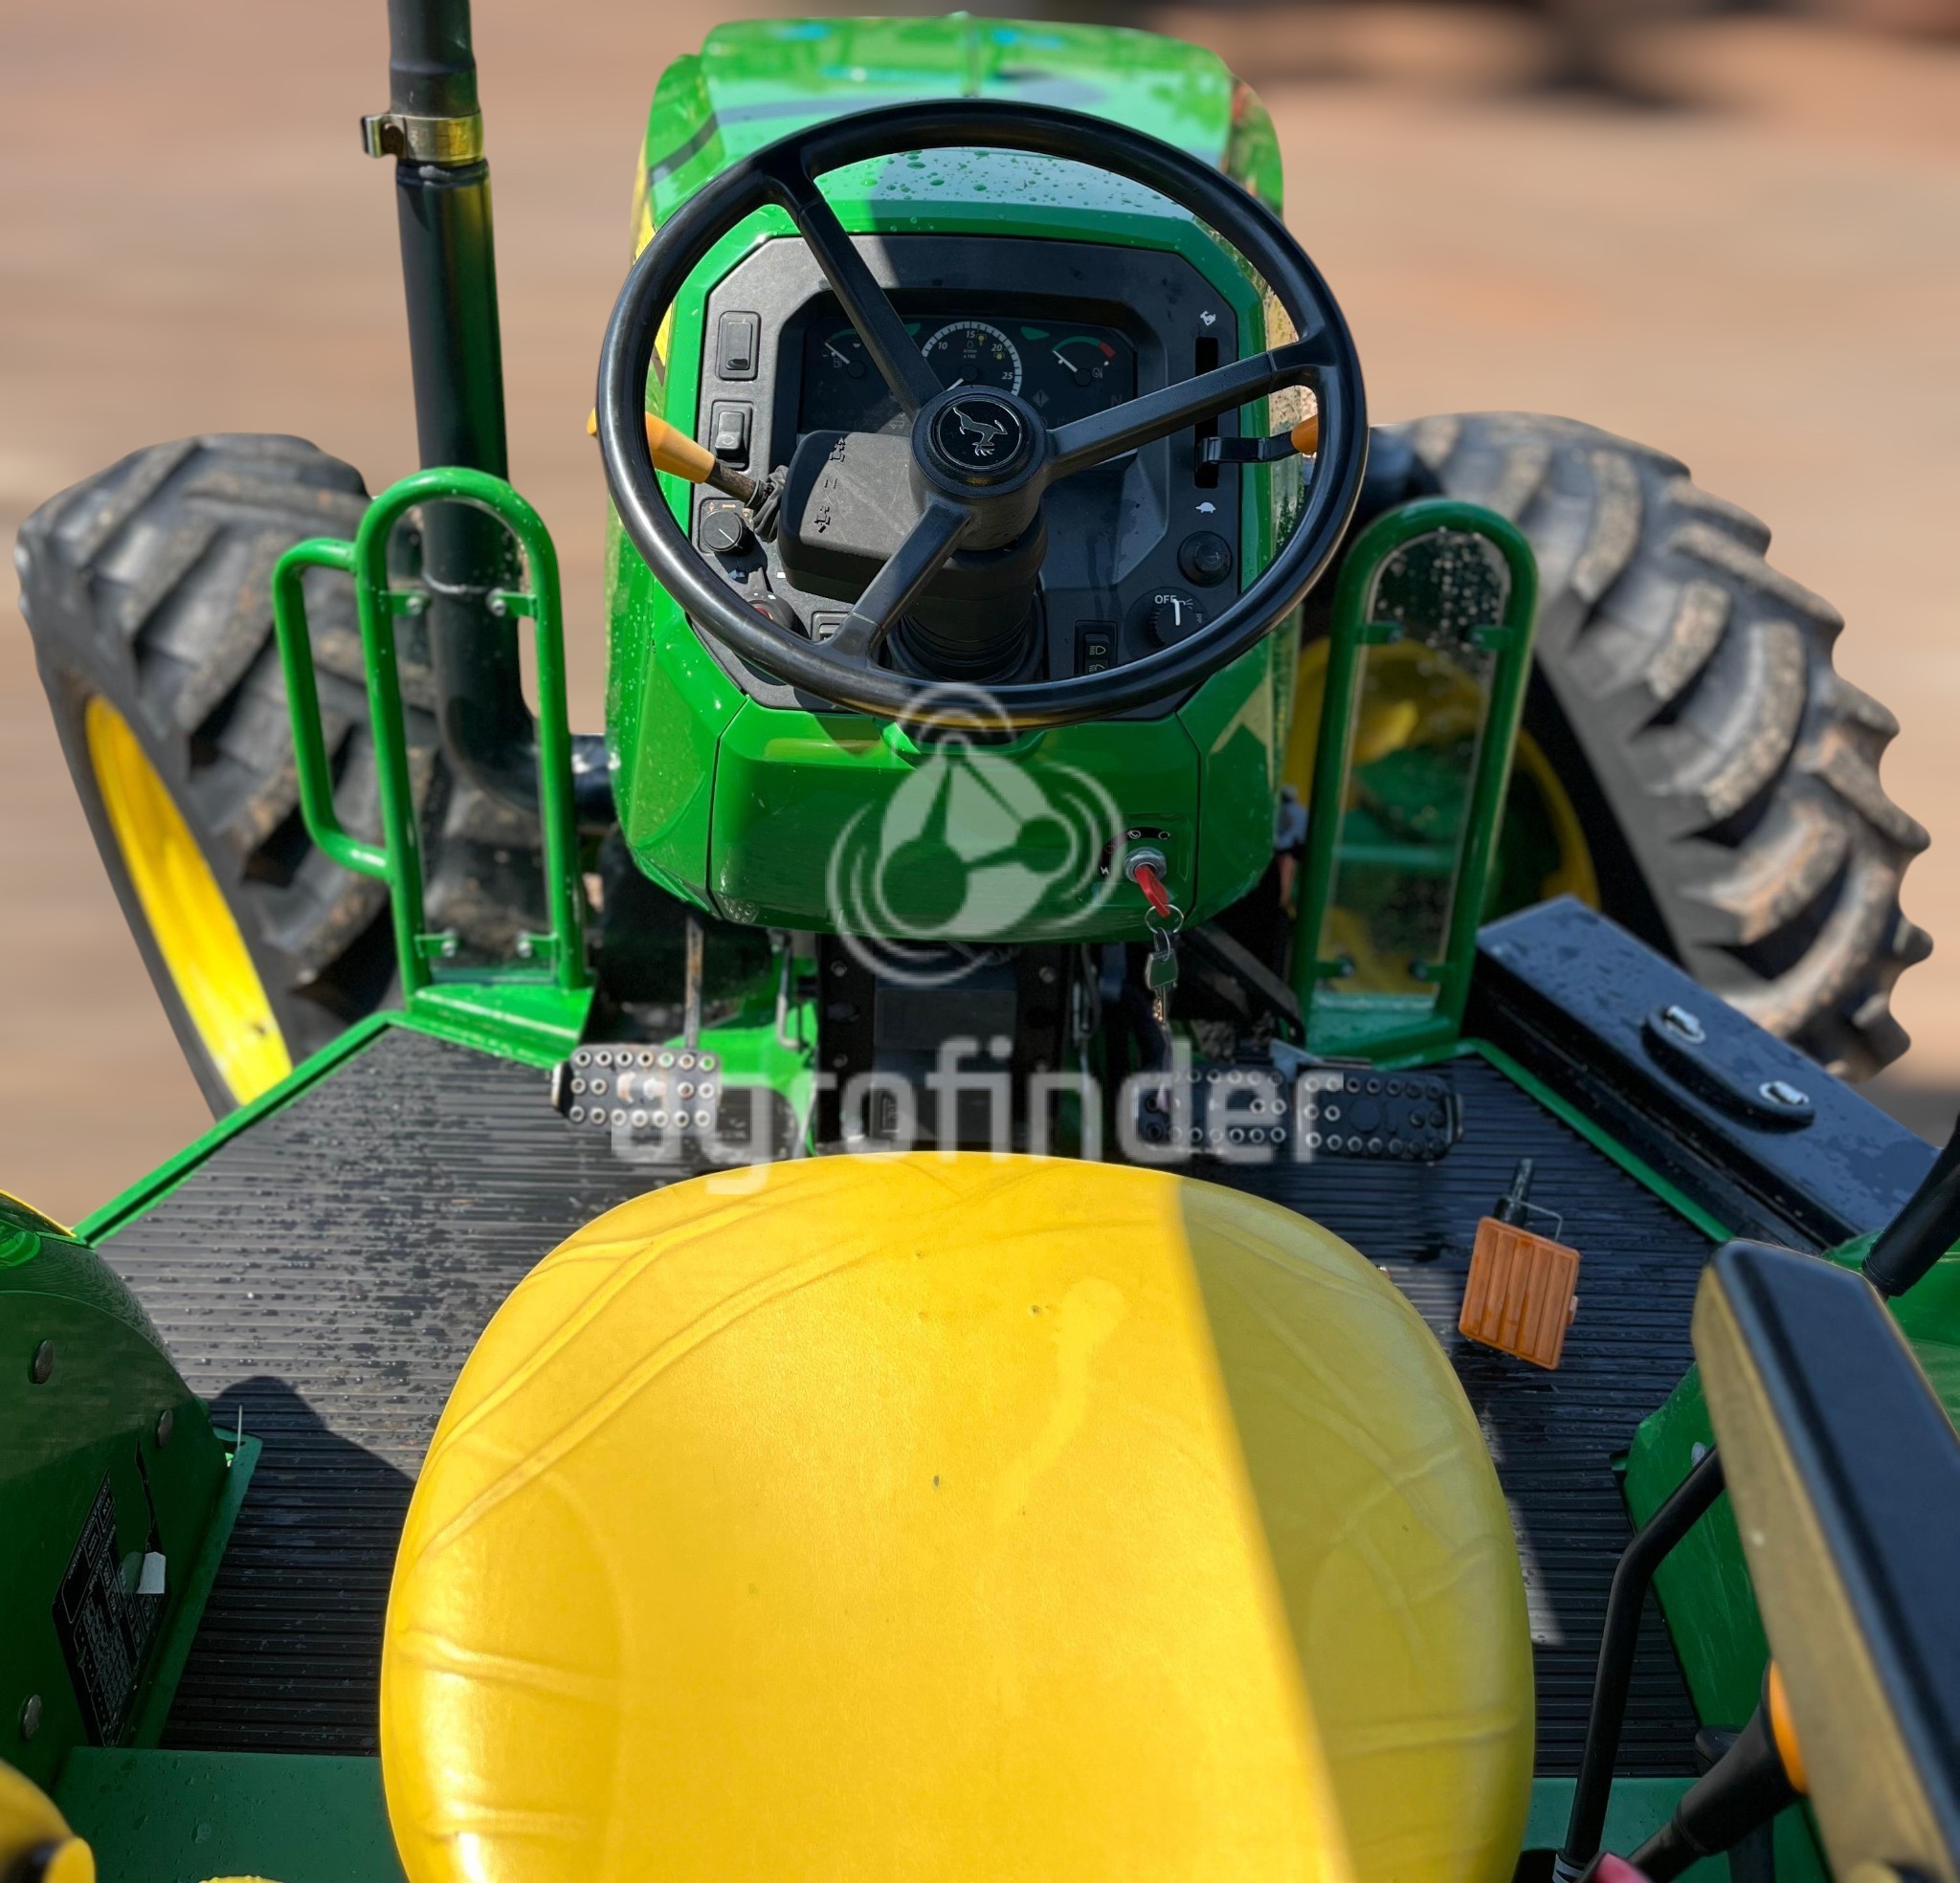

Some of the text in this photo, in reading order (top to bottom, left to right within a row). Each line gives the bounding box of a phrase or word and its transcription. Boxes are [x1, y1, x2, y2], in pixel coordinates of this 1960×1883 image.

[966, 330, 975, 339] 15
[938, 342, 947, 350] 10
[991, 343, 1003, 352] 20
[1001, 371, 1013, 380] 25
[1154, 594, 1177, 604] OFF
